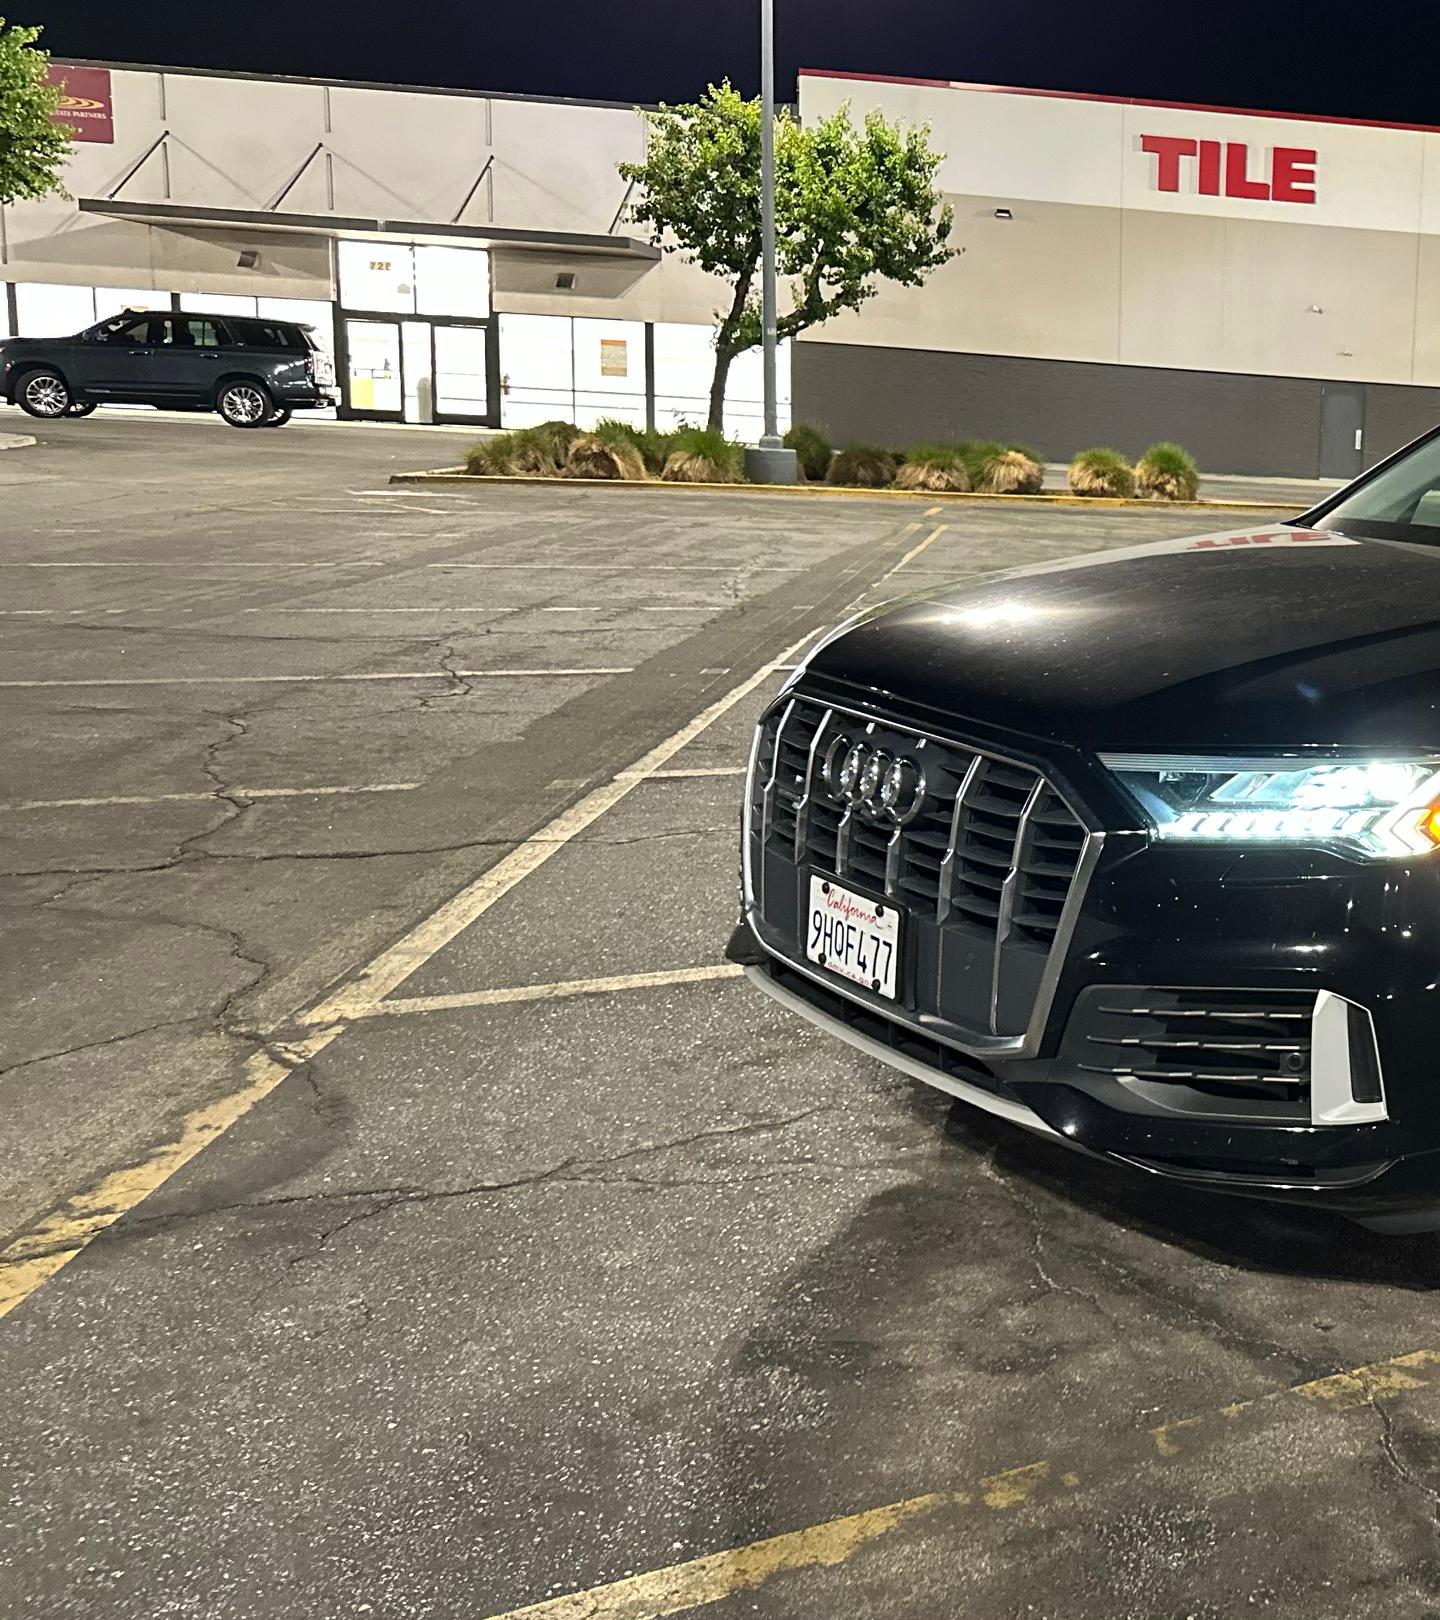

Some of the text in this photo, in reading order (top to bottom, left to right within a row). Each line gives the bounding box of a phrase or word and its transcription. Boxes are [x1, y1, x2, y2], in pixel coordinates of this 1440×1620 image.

[72, 111, 107, 119] PARTNERS
[1140, 134, 1317, 205] TILE
[827, 888, 877, 924] California
